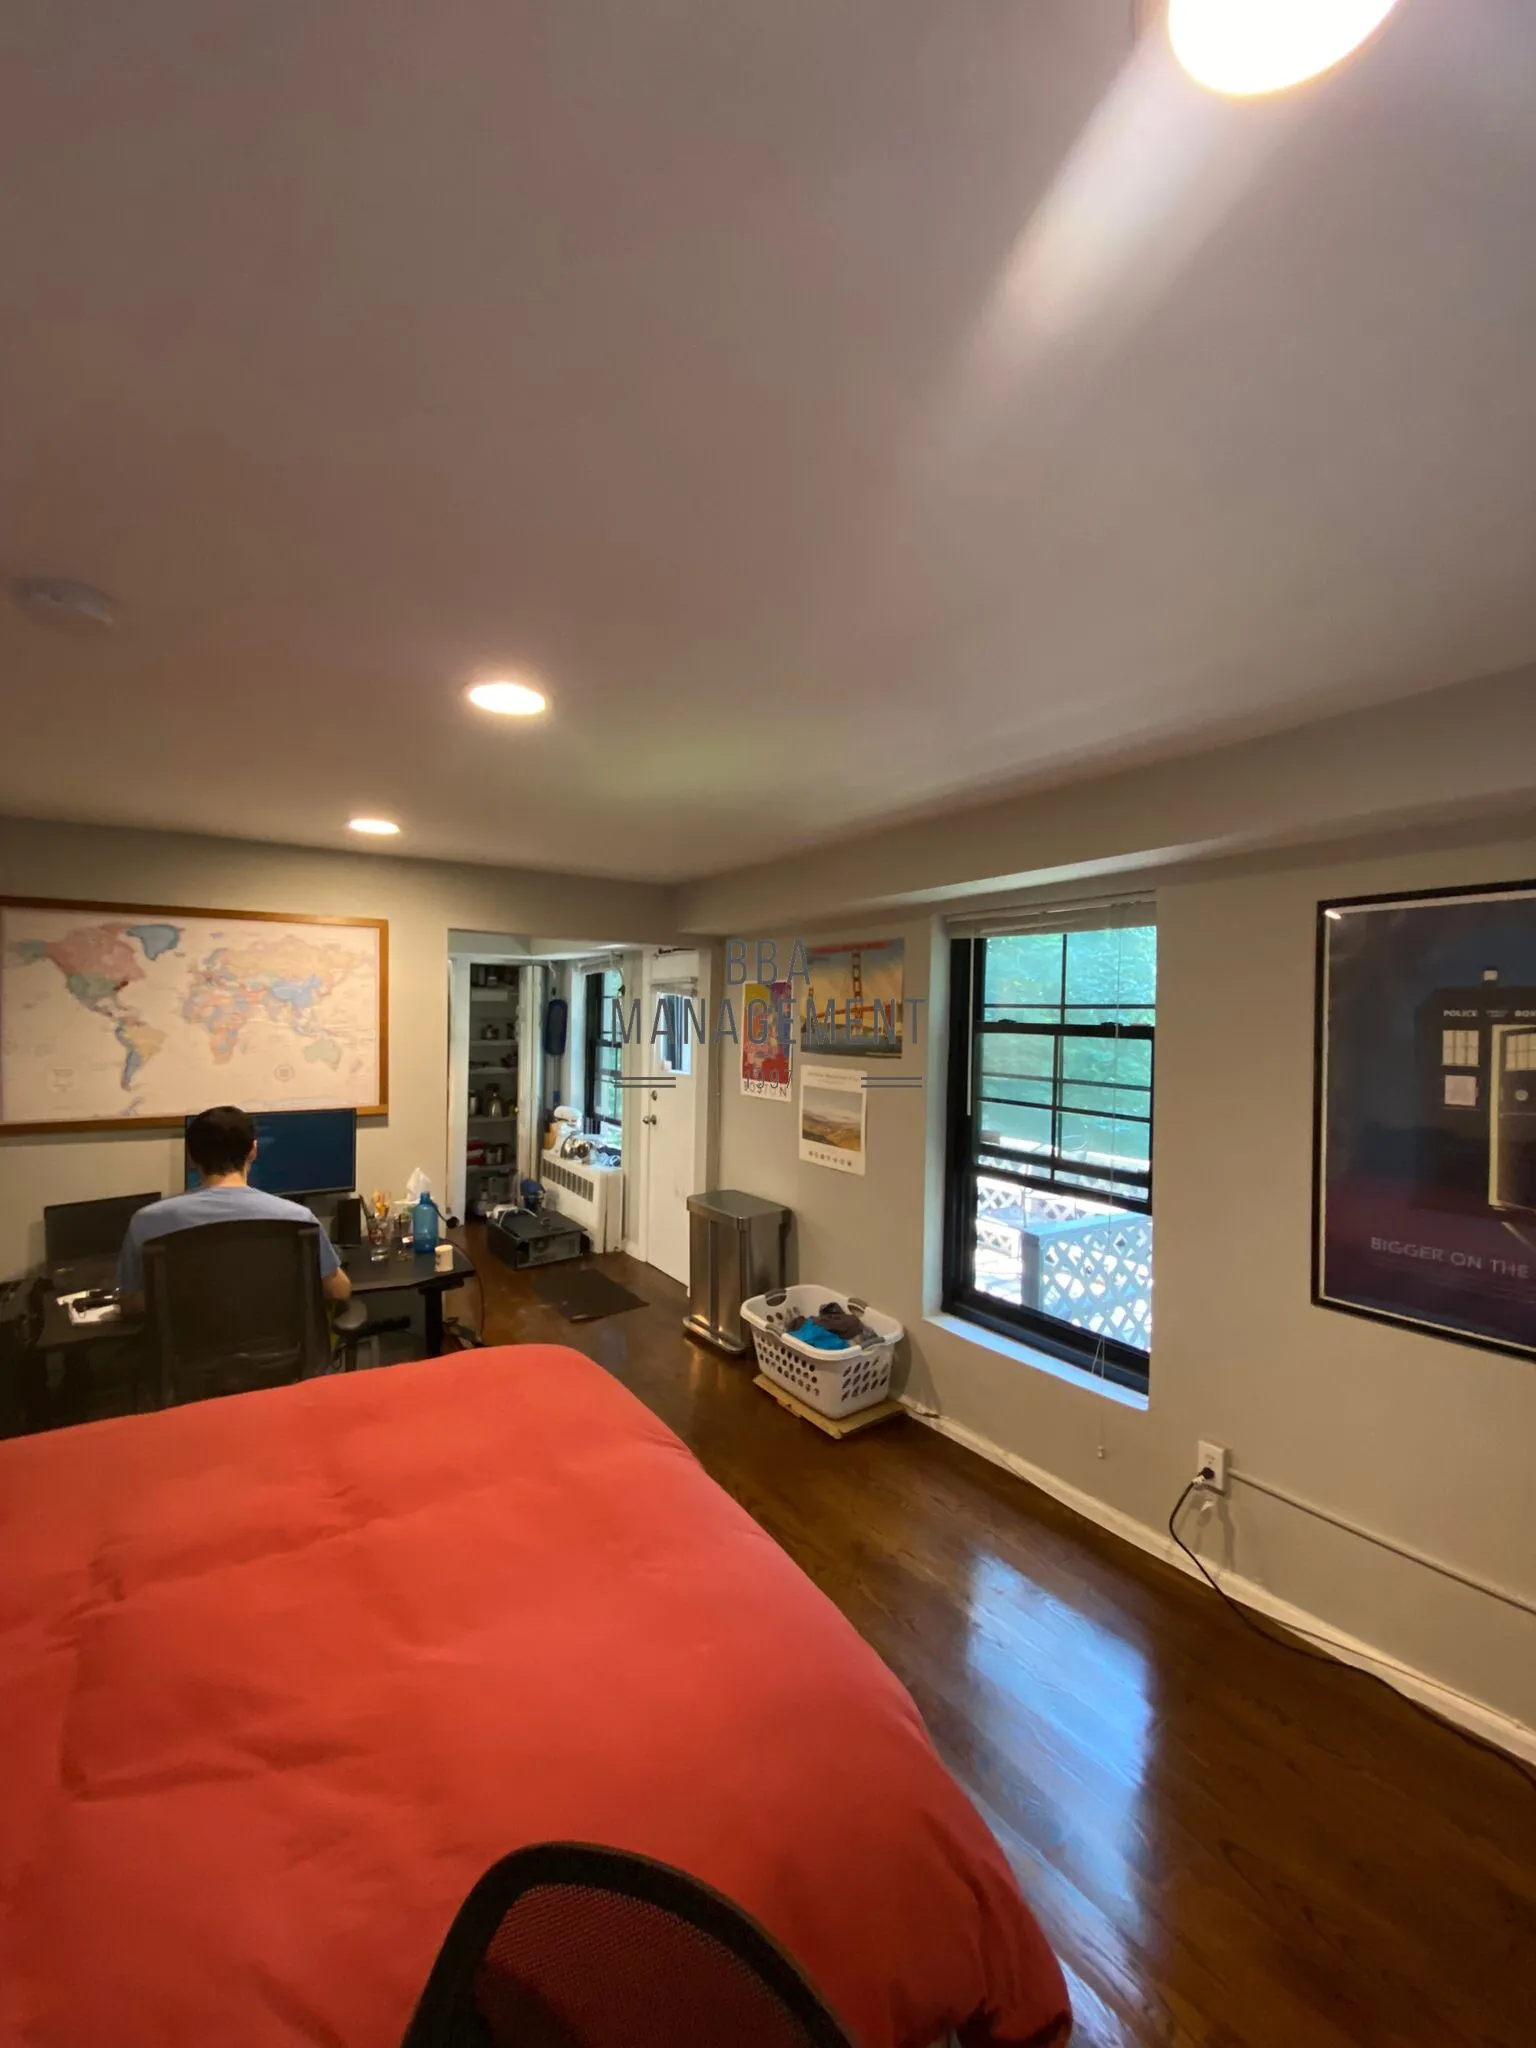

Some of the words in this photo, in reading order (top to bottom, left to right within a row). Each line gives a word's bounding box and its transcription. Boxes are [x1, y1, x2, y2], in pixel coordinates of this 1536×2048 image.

[1443, 1009, 1478, 1018] POLICE
[1370, 1236, 1445, 1263] BIGGER
[1450, 1251, 1483, 1270] ON
[1489, 1258, 1531, 1280] THE
